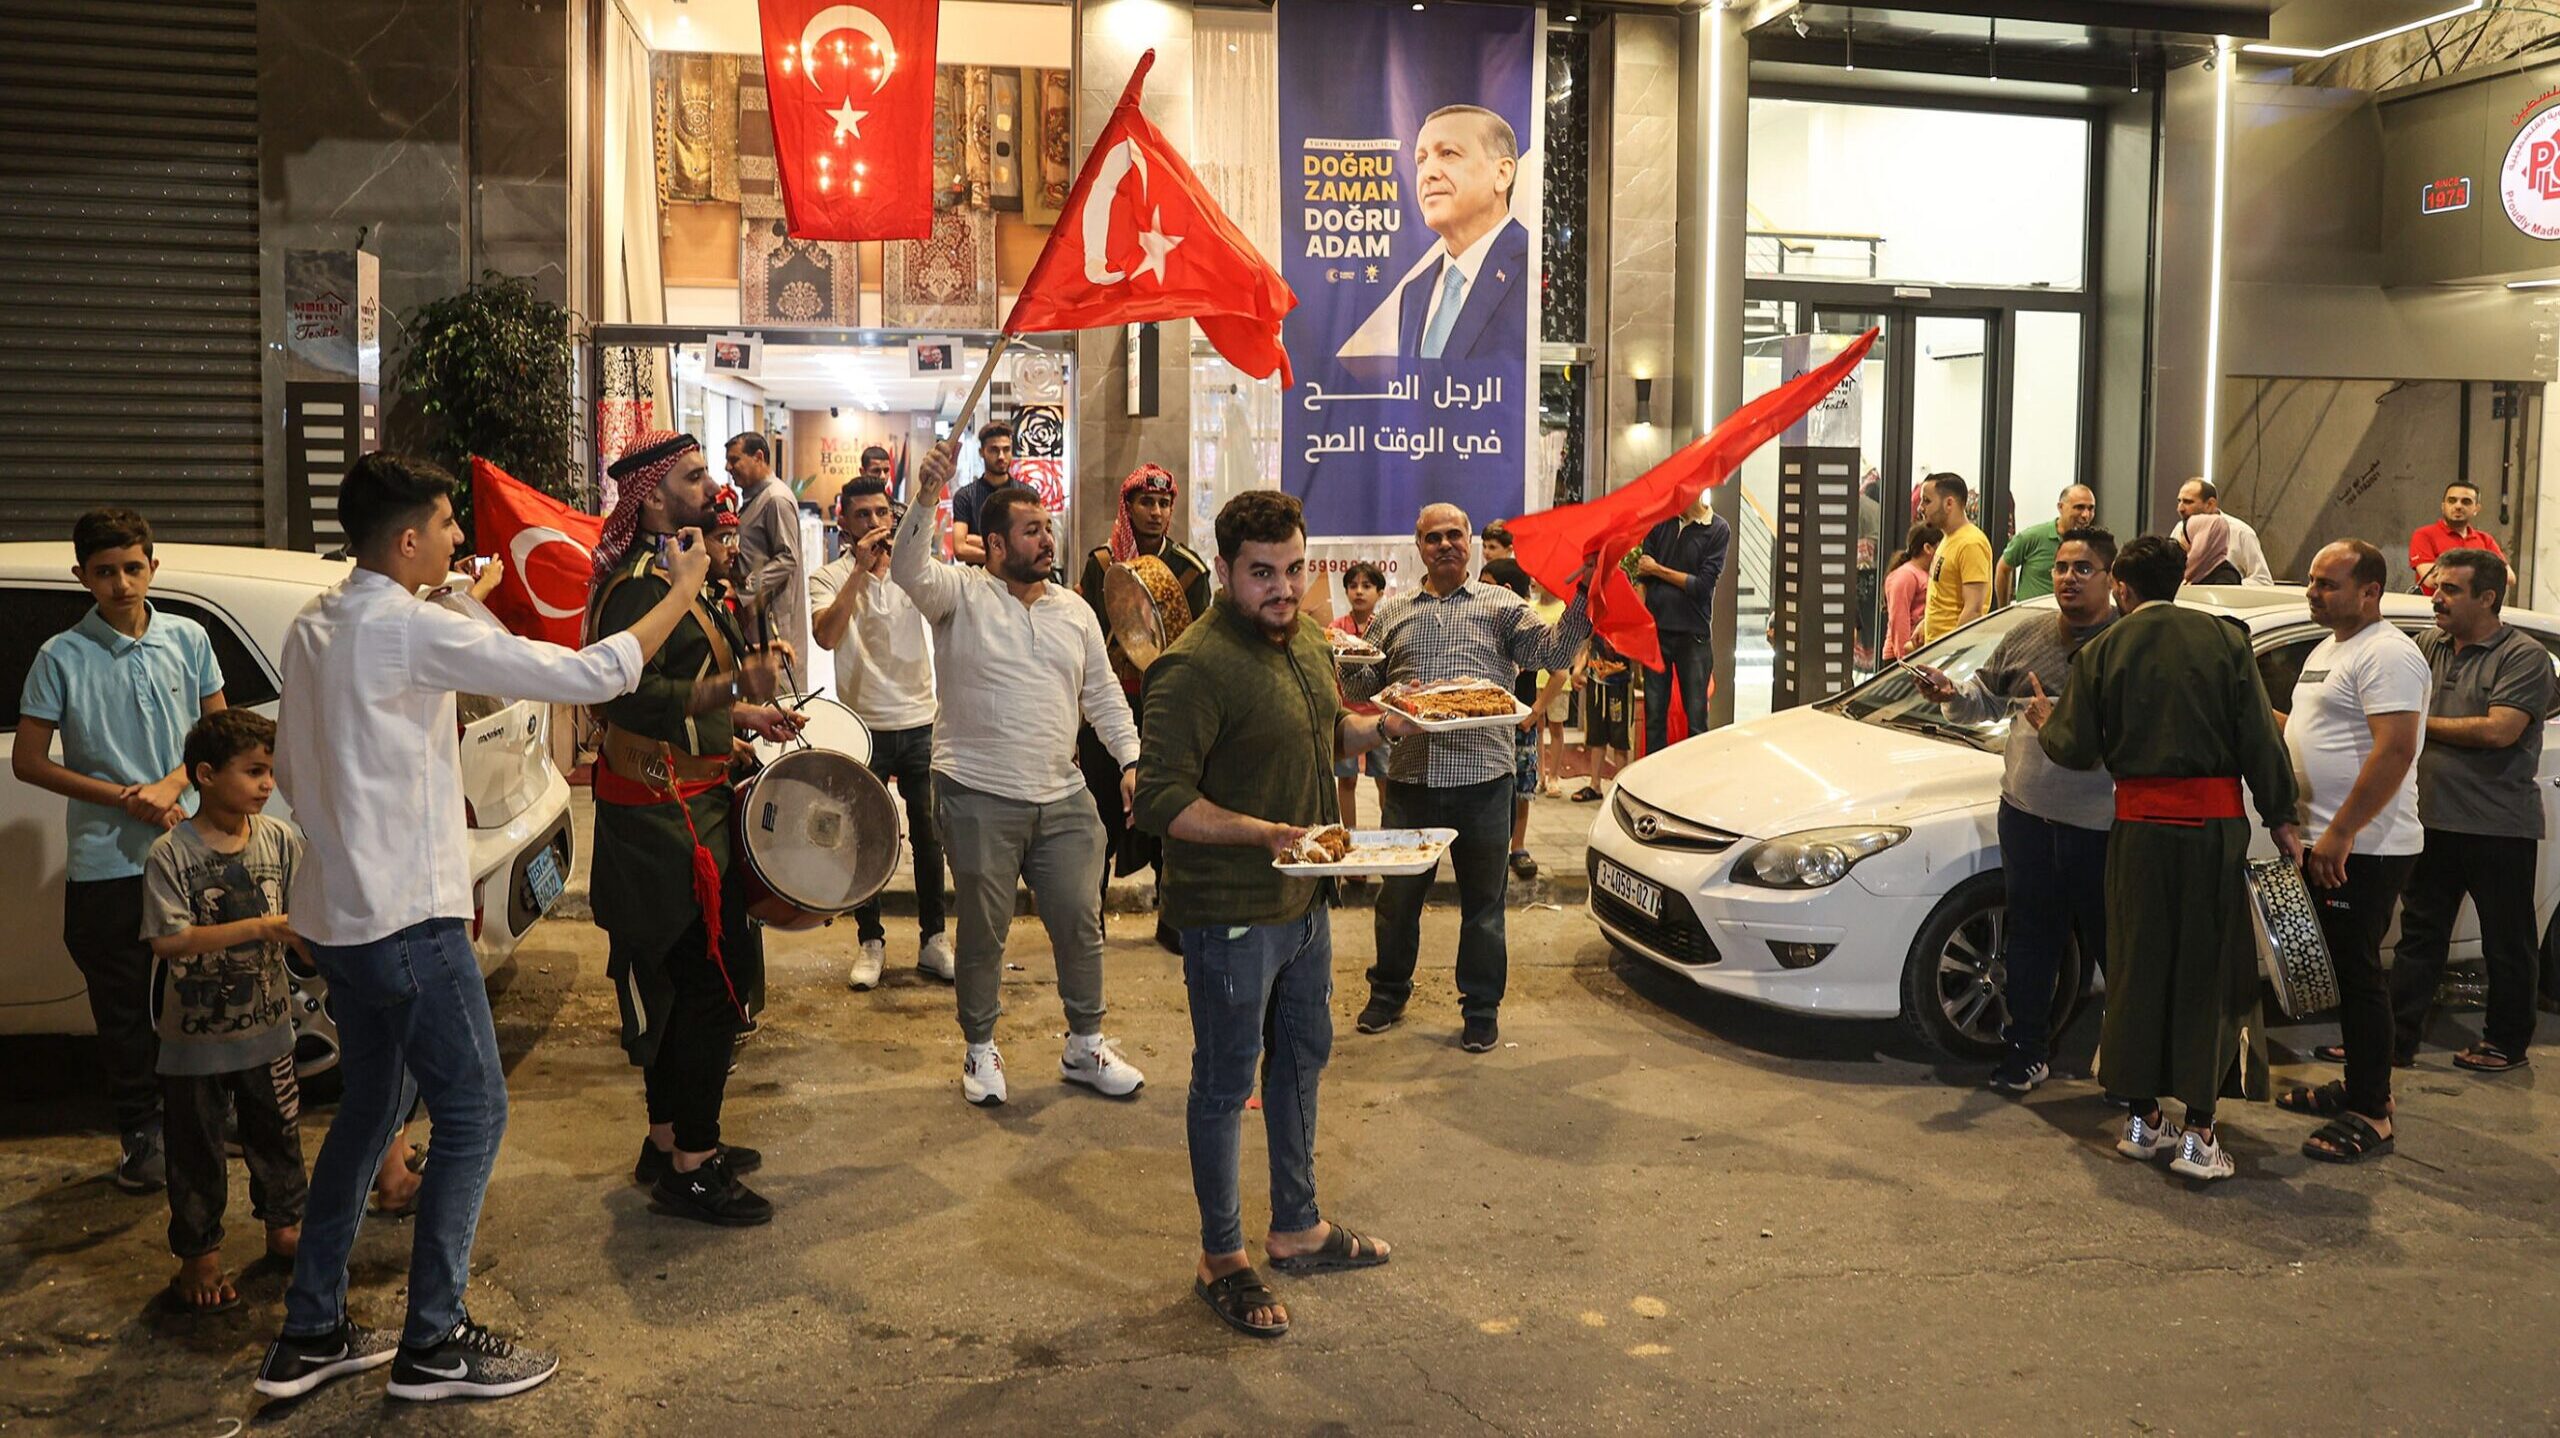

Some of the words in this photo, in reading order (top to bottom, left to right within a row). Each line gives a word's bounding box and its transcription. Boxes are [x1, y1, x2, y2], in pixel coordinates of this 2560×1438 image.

[1304, 152, 1393, 178] DOĞRU
[1303, 180, 1398, 202] ZAMAN
[2434, 177, 2460, 189] SINCE
[2427, 187, 2466, 208] 1975
[1304, 204, 1401, 232] DOĞRU
[2505, 189, 2531, 230] Proudly
[2530, 222, 2560, 237] Made
[1305, 235, 1391, 258] ADAM
[294, 322, 339, 341] Textile
[1433, 376, 1502, 410] الرجل
[1304, 426, 1365, 464] الصح
[1373, 426, 1444, 460] الوقت
[1452, 428, 1502, 460] في
[821, 452, 858, 464] Hom
